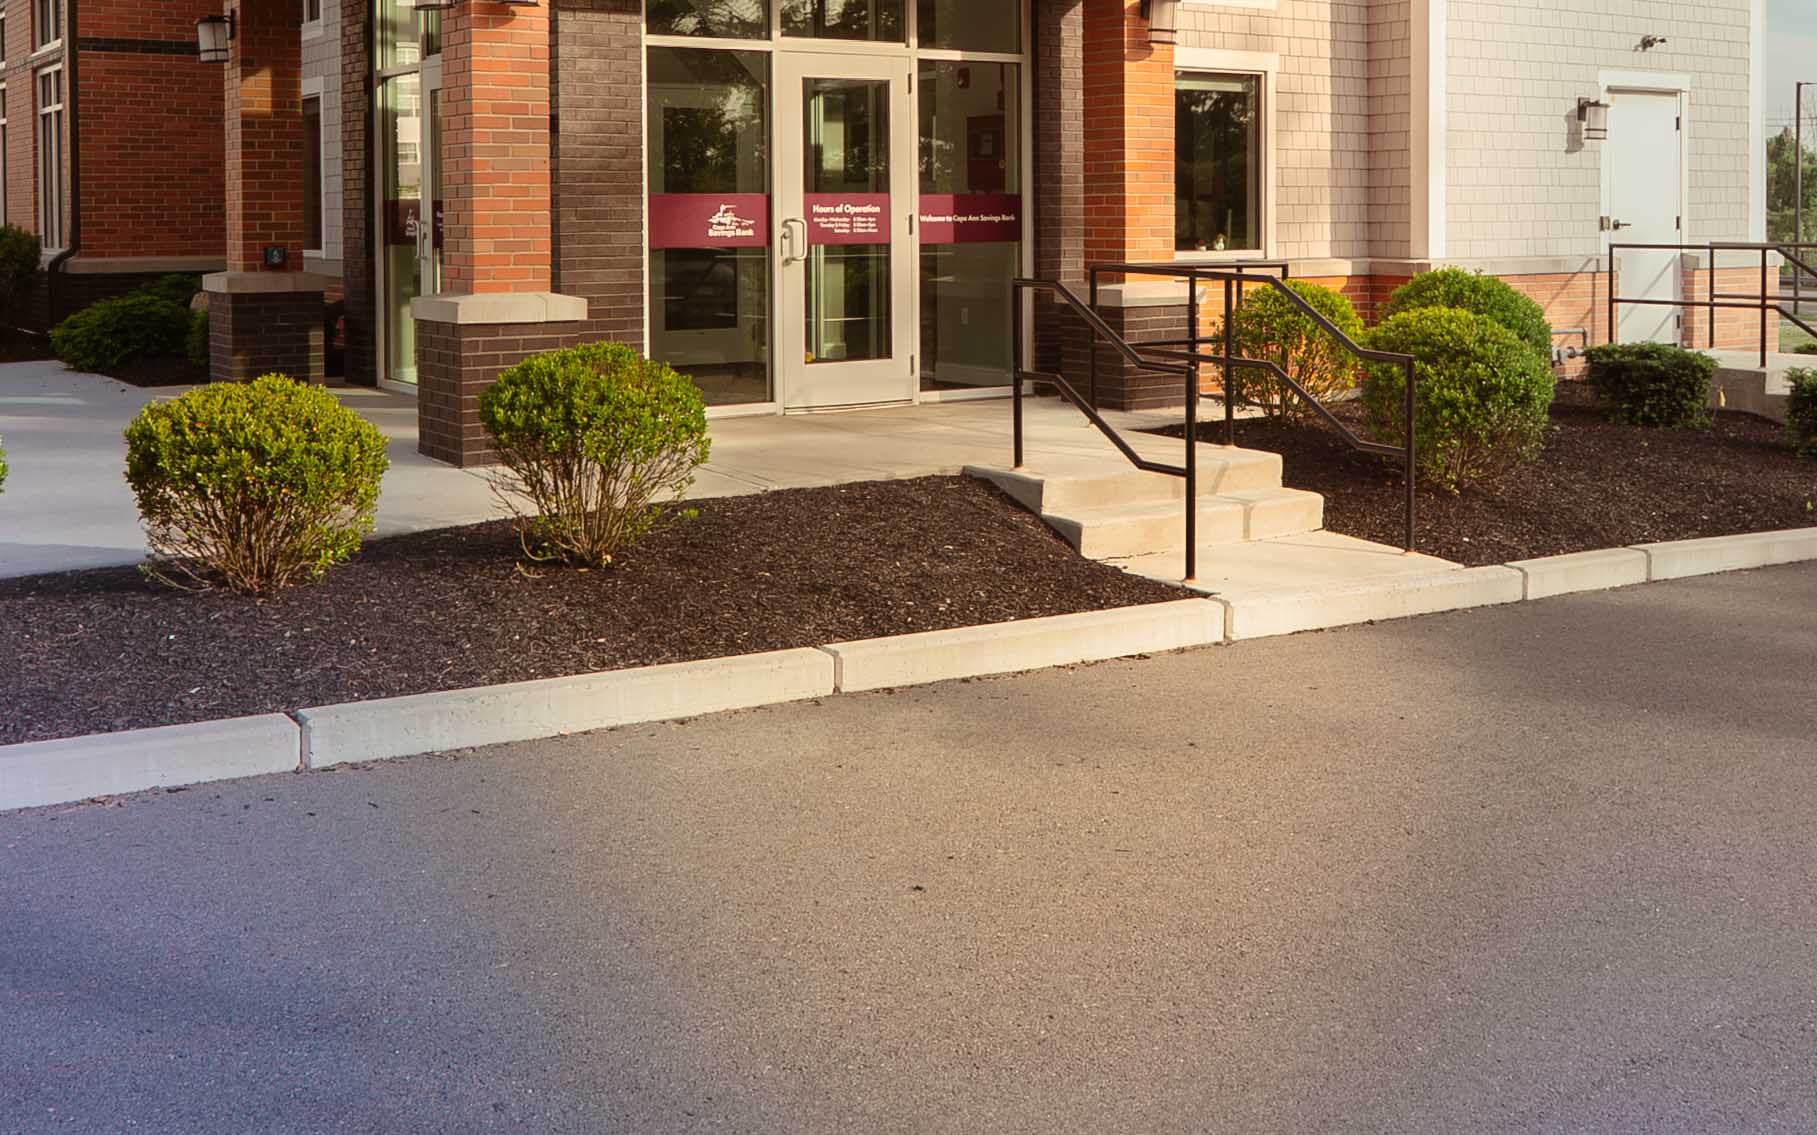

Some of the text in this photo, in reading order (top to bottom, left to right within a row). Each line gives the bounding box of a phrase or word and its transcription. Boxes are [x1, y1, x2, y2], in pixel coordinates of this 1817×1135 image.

[812, 204, 880, 215] Hours of Operation
[920, 214, 946, 222] Welcome
[953, 215, 967, 223] Cape
[980, 214, 1001, 223] Savings
